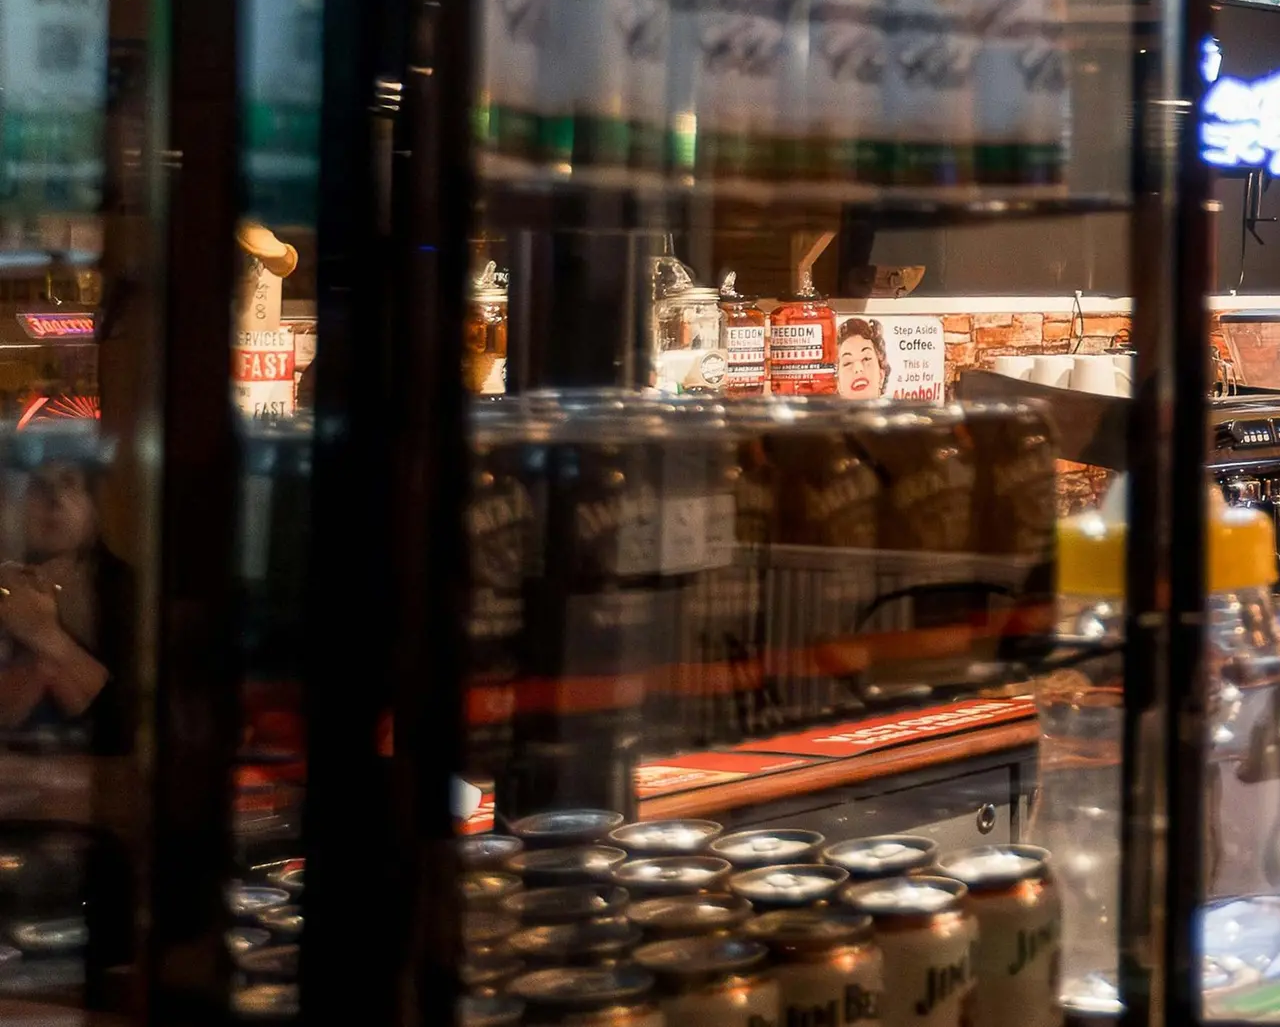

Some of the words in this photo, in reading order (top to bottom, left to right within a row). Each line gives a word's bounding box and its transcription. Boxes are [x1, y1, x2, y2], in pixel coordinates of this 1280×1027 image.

[894, 326, 913, 335] Step
[916, 326, 937, 334] Aside
[899, 339, 936, 350] Coffee.
[241, 353, 288, 379] FAST
[903, 360, 919, 369] This
[922, 360, 929, 369] is
[905, 373, 919, 382] Job
[922, 372, 934, 381] for
[893, 383, 941, 401] Alcohol!
